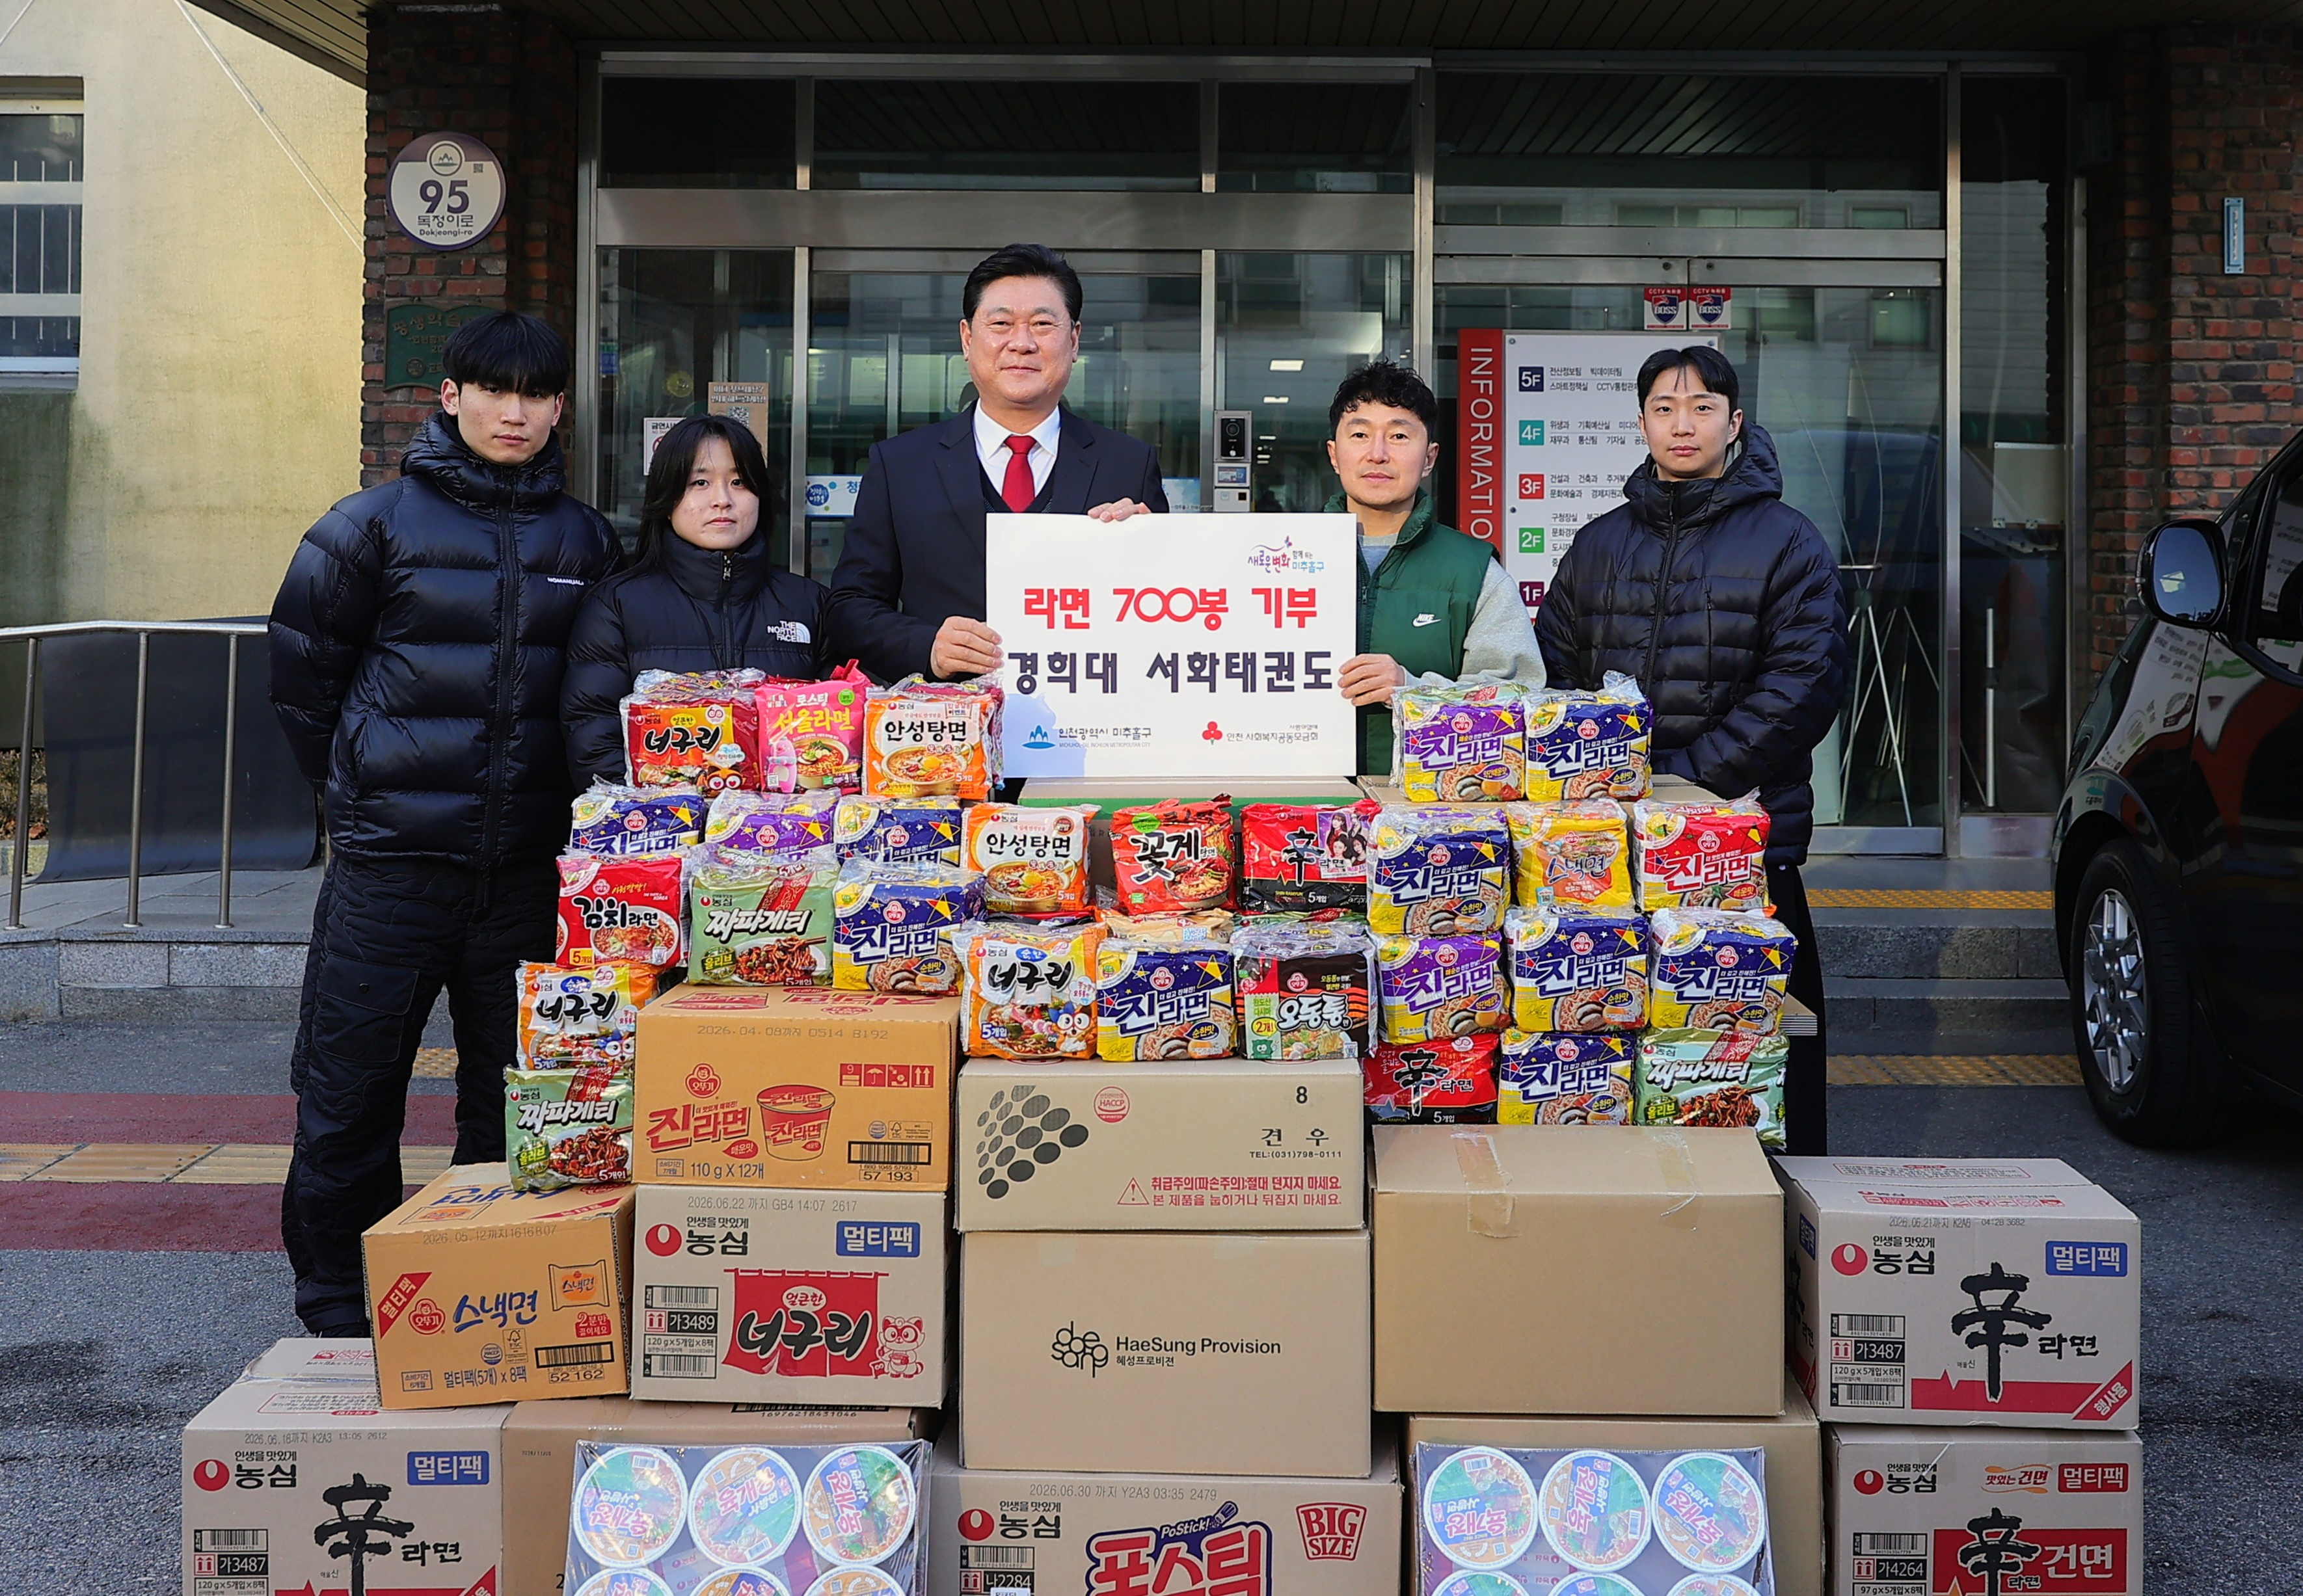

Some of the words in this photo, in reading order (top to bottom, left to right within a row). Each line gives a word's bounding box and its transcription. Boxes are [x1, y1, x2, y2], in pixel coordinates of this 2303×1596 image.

[420, 180, 469, 213] 95
[418, 215, 473, 227] 독정이로
[1699, 306, 1721, 314] BOSS
[1521, 371, 1541, 388] 5F
[1550, 367, 1582, 377] 전산정보팀
[1591, 367, 1623, 377] 빅데이터팀
[1550, 382, 1588, 392] 스마트정책실
[1521, 424, 1541, 441] 4F
[1550, 421, 1570, 430] 위생과
[1470, 347, 1493, 541] INFORMATIO
[1550, 436, 1570, 445] 재무과
[1578, 436, 1598, 445] 통신팀
[1606, 436, 1626, 445] 기자실
[1521, 478, 1541, 494] 3F
[1550, 474, 1570, 483] 건설과
[1578, 474, 1598, 483] 건축과
[1550, 489, 1583, 498] 문화예술과
[1552, 513, 1578, 522] 구청장실
[1521, 531, 1541, 548] 2F
[1248, 550, 1271, 573] 새로운
[1272, 552, 1291, 573] 변화
[1293, 550, 1303, 559] 함께
[1292, 561, 1325, 573] 미추홀구
[1523, 586, 1541, 602] 1F
[1024, 588, 1090, 629] 라면
[1113, 587, 1229, 631] 700봉
[1252, 588, 1317, 628] 기부
[768, 626, 796, 635] NORTH
[777, 633, 796, 643] FACE
[1008, 652, 1118, 695] 경희대
[1146, 651, 1332, 693] 서화태권도
[796, 693, 829, 708] 로스팅
[672, 717, 694, 726] 얼큰한
[885, 721, 967, 742] 안성탕면
[1058, 727, 1109, 739] 인천광역시
[1112, 727, 1152, 740] 미추홀구
[1226, 732, 1243, 741] 인천
[1245, 732, 1319, 743] 사회복지공동모금회
[986, 833, 1071, 857] 안성탕면
[573, 898, 658, 928] 김치라면
[704, 907, 812, 944] 짜파게티
[1021, 948, 1043, 959] 순한
[704, 955, 733, 970] 올리브
[988, 961, 1072, 991] 너구리
[1253, 998, 1272, 1007] 완도산
[1608, 992, 1629, 1005] 순한맛
[536, 991, 618, 1022] 너구리
[1253, 1007, 1272, 1017] 다시마
[809, 1028, 844, 1039] 0514
[981, 1024, 1008, 1038] 5개입
[1256, 1020, 1274, 1033] 2개!
[847, 1065, 854, 1074] 9
[693, 1082, 714, 1092] 오뚜기
[1296, 1085, 1308, 1104] 8
[517, 1100, 619, 1137] 짜파게티
[1433, 1111, 1455, 1124] 5개입
[646, 1104, 751, 1152] 진라면
[730, 1144, 754, 1155] 매운맛
[1250, 1150, 1342, 1159] TEL:(031)798-0111
[599, 1170, 625, 1180] 5개입
[691, 1163, 710, 1177] 110
[714, 1166, 722, 1180] g
[738, 1163, 764, 1179] 12개
[863, 1171, 881, 1181] 57
[887, 1172, 913, 1182] 193
[1272, 1176, 1304, 1190] 던지지
[1307, 1176, 1342, 1190] 마세요.
[688, 1197, 744, 1210] 2026.06.22
[747, 1197, 768, 1210] 까지
[772, 1199, 794, 1212] GB4
[798, 1200, 826, 1211] 14:07
[832, 1201, 857, 1212] 2617
[1152, 1194, 1165, 1207] 본
[1169, 1194, 1205, 1206] 제품을
[1262, 1194, 1299, 1206] 뒤집지
[686, 1216, 716, 1228] 인생을
[718, 1216, 749, 1229] 맛있게
[1889, 1216, 1949, 1229] 2026.06.21까지
[1953, 1217, 1971, 1228] K2A6
[686, 1230, 748, 1256] 농심
[844, 1226, 913, 1253] 멀티팩
[1872, 1235, 1902, 1247] 인생을
[1904, 1236, 1935, 1247] 맛있게
[1872, 1249, 1935, 1275] 농심
[2053, 1245, 2121, 1273] 멀티팩
[562, 1277, 595, 1293] 스낵면
[785, 1292, 824, 1307] 얼큰한
[453, 1289, 539, 1333] 스낵면
[415, 1315, 440, 1327] 오뚜기
[578, 1312, 608, 1327] 2분만
[670, 1314, 715, 1331] 가3489
[579, 1327, 608, 1336] 끓이세요
[738, 1311, 870, 1359] 너구리
[1951, 1262, 2053, 1403] 辛
[1116, 1336, 1196, 1356] HaeSung
[1201, 1338, 1281, 1355] Provision
[1857, 1342, 1903, 1359] 가3487
[2038, 1333, 2100, 1361] 라면
[1116, 1355, 1175, 1367] 혜성프로비젼
[404, 1373, 429, 1381] 소비기간
[444, 1367, 497, 1389] 멀티팩(5개)
[501, 1372, 507, 1383] x
[510, 1366, 527, 1383] 8팩
[550, 1372, 570, 1383] 52
[574, 1370, 604, 1380] 162
[2093, 1383, 2128, 1416] 행사용
[312, 1433, 332, 1444] K2A3
[368, 1432, 388, 1441] 2612
[234, 1450, 265, 1462] 인생을
[266, 1450, 297, 1462] 맛있게
[234, 1463, 297, 1489] 농심
[414, 1455, 483, 1482] 멀티팩
[1986, 1473, 2017, 1486] 맛있는
[2018, 1470, 2049, 1485] 건면
[1029, 1484, 1092, 1498] 2026.06.30
[1095, 1485, 1118, 1499] 까지
[1122, 1487, 1150, 1499] Y2A3
[1153, 1487, 1185, 1500] 03:35
[1189, 1489, 1217, 1502] 2479
[999, 1500, 1029, 1513] 인생을
[1030, 1501, 1062, 1514] 맛있게
[1300, 1503, 1361, 1537] BIG
[1160, 1518, 1210, 1539] PoStick!
[401, 1541, 463, 1563] 라면
[1306, 1537, 1354, 1558] SIZE
[219, 1556, 266, 1574] 가3487
[2041, 1543, 2113, 1578] 건면
[1878, 1561, 1924, 1577] 가4264
[198, 1581, 213, 1589] 120
